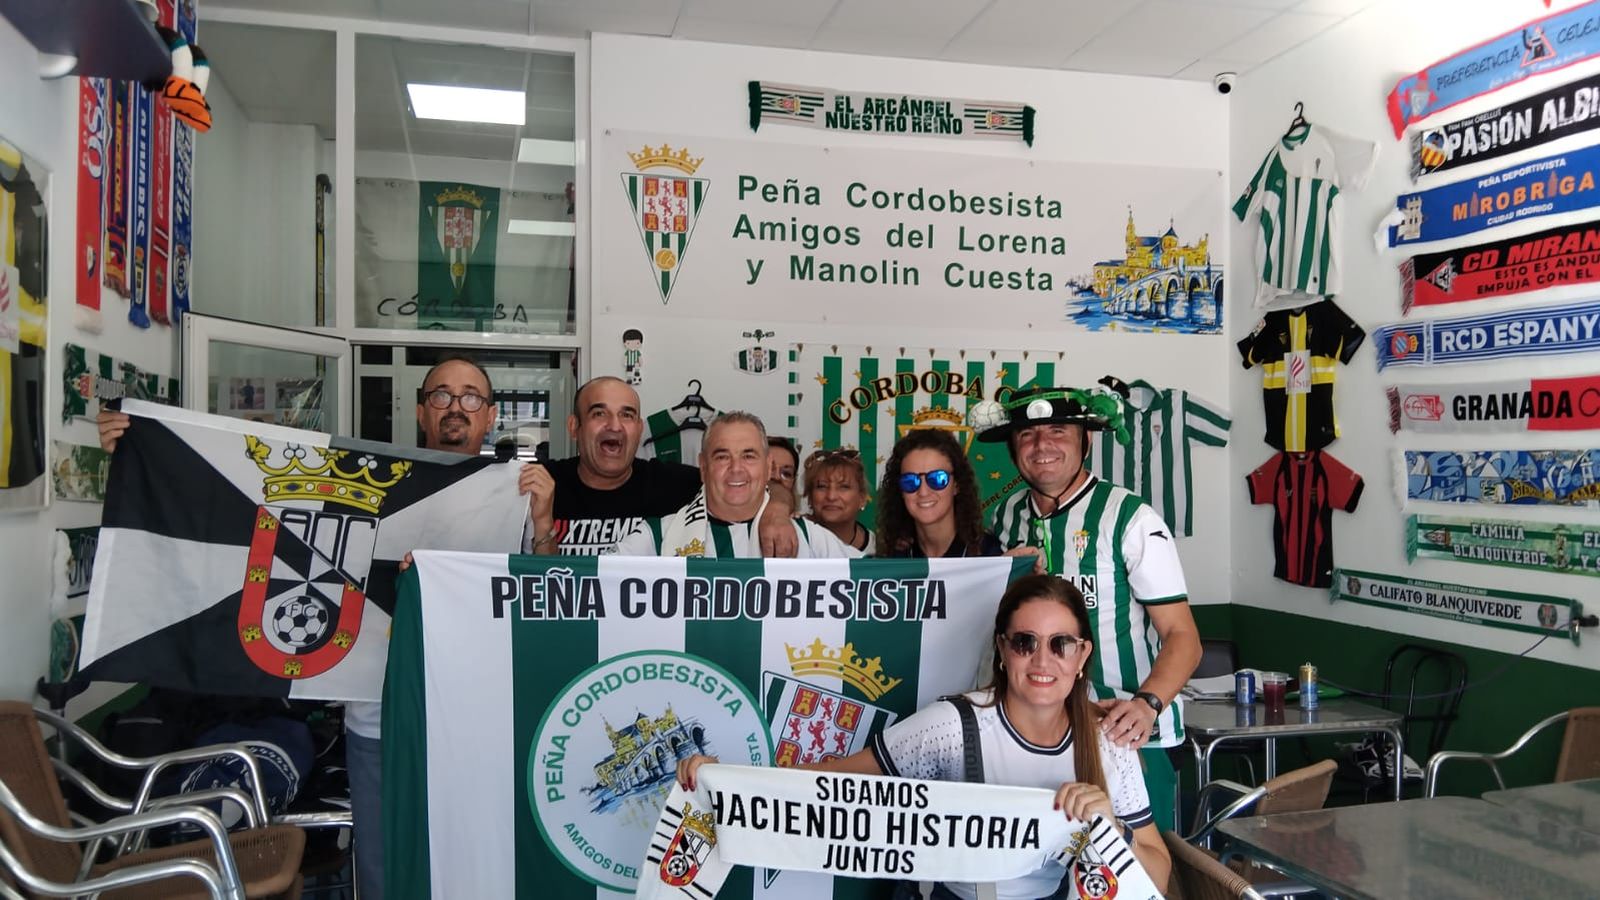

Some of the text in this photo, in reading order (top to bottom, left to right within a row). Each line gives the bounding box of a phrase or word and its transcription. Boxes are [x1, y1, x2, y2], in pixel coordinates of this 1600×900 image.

[1436, 45, 1521, 91] PREFERENCIA
[825, 111, 963, 135] NUESTRO REINO
[835, 95, 955, 118] EL ARCÁNGEL
[1447, 86, 1600, 161] PASIÓN ALBI
[1478, 158, 1566, 189] PEÑA DEPORTIVISTA
[738, 175, 1062, 219] Peña Cordobesista
[732, 213, 1066, 255] Amigos del Lorena
[746, 255, 1053, 291] y Manolin Cuesta
[1462, 249, 1499, 272] CD
[1495, 266, 1529, 280] ESTO
[1534, 263, 1549, 273] ES
[1477, 268, 1592, 295] EMPUJA CON EL
[1441, 327, 1487, 352] RCD
[1494, 313, 1600, 347] ESPANY
[828, 370, 985, 425] CORDOBA
[1452, 390, 1573, 421] GRANADA
[1471, 522, 1525, 541] FAMILIA
[1453, 544, 1548, 566] BLANQUIVERDE
[490, 567, 948, 622] PEÑA CORDOBESISTA
[1370, 584, 1423, 605] CALIFATO
[1426, 594, 1522, 620] BLANQUIVERDE
[543, 663, 743, 803] PEÑA CORDOBESISTA
[816, 776, 929, 809] SIGAMOS
[709, 790, 1040, 849] HACIENDO HISTORIA
[563, 822, 640, 880] AMIGOS DEL
[823, 844, 915, 874] JUNTOS
